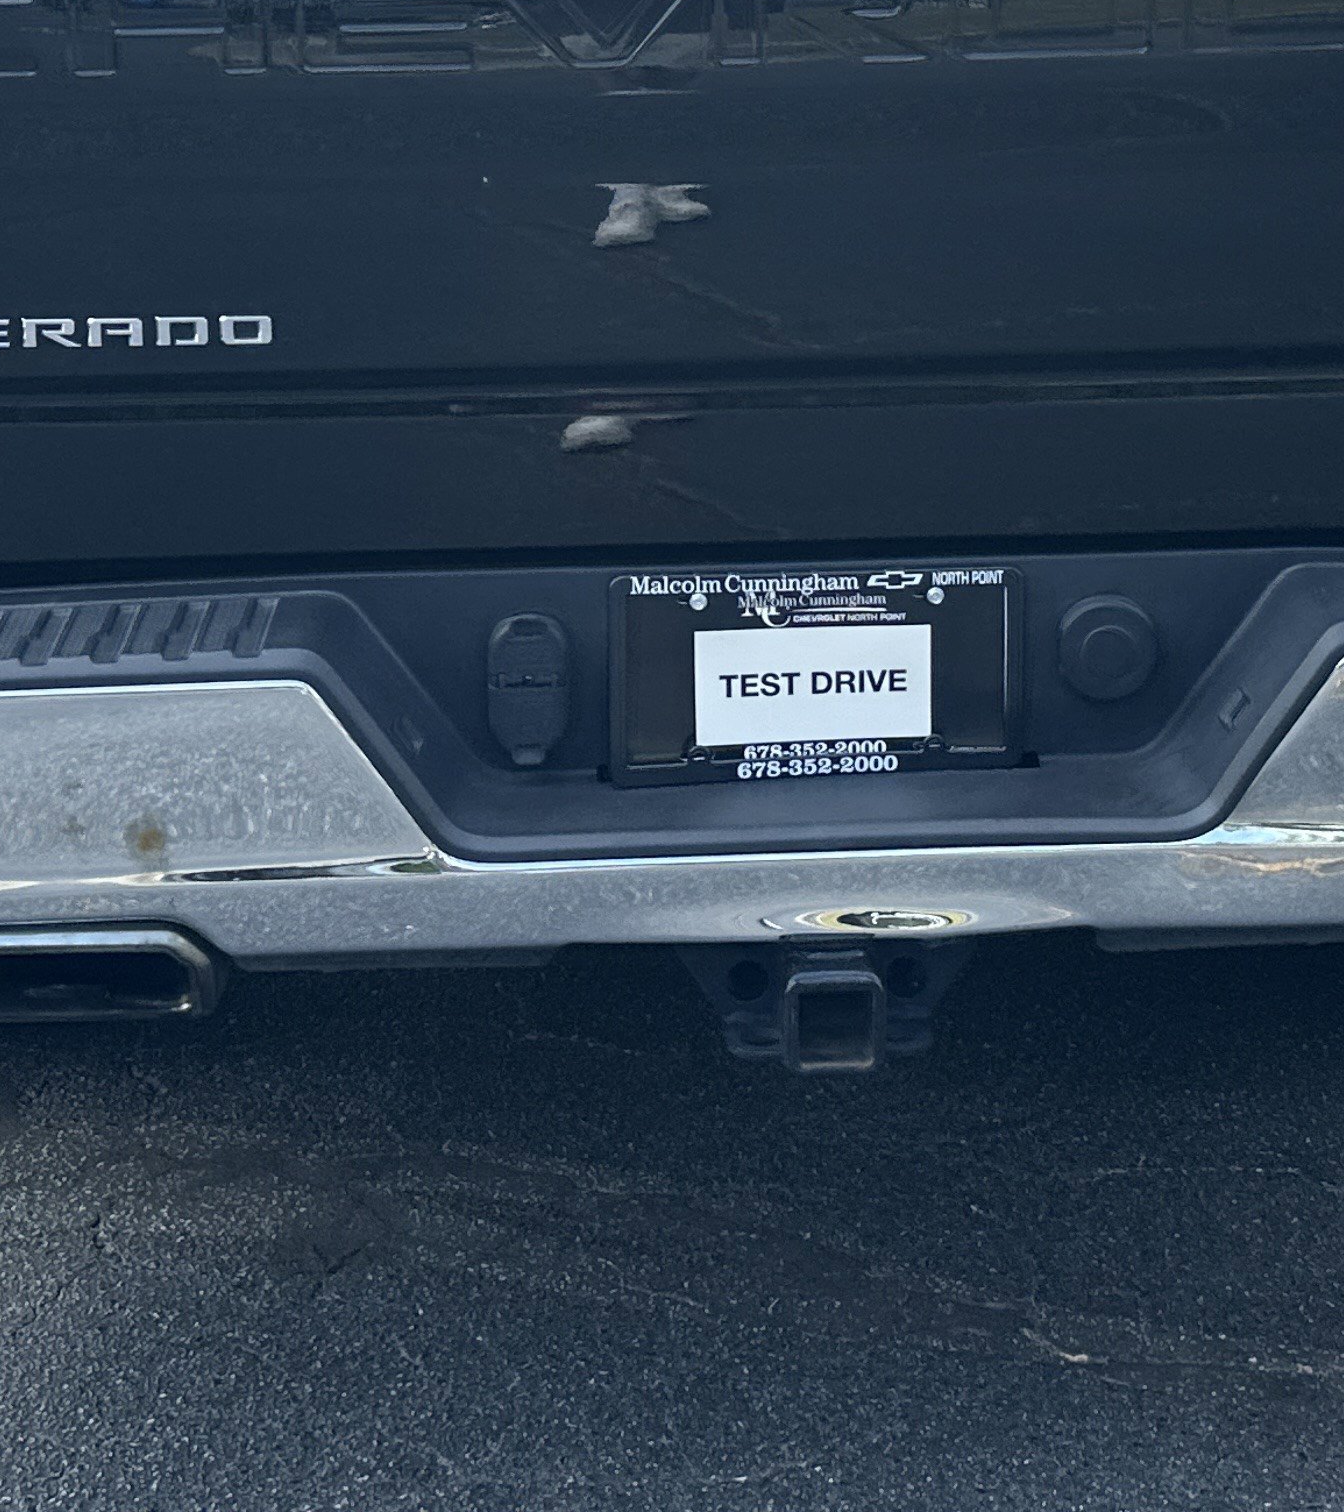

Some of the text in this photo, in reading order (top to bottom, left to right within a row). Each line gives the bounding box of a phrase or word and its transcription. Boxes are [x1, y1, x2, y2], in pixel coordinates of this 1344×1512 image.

[629, 569, 1004, 596] Malcolm Cunningham NORTH POINT
[737, 592, 887, 610] Malcolm Cunningham
[792, 611, 907, 623] CHEVROLET NORTH POINT
[719, 669, 908, 698] TEST DRIVE
[743, 740, 887, 760] 678-352-2000
[737, 755, 899, 779] 678-352-2000
